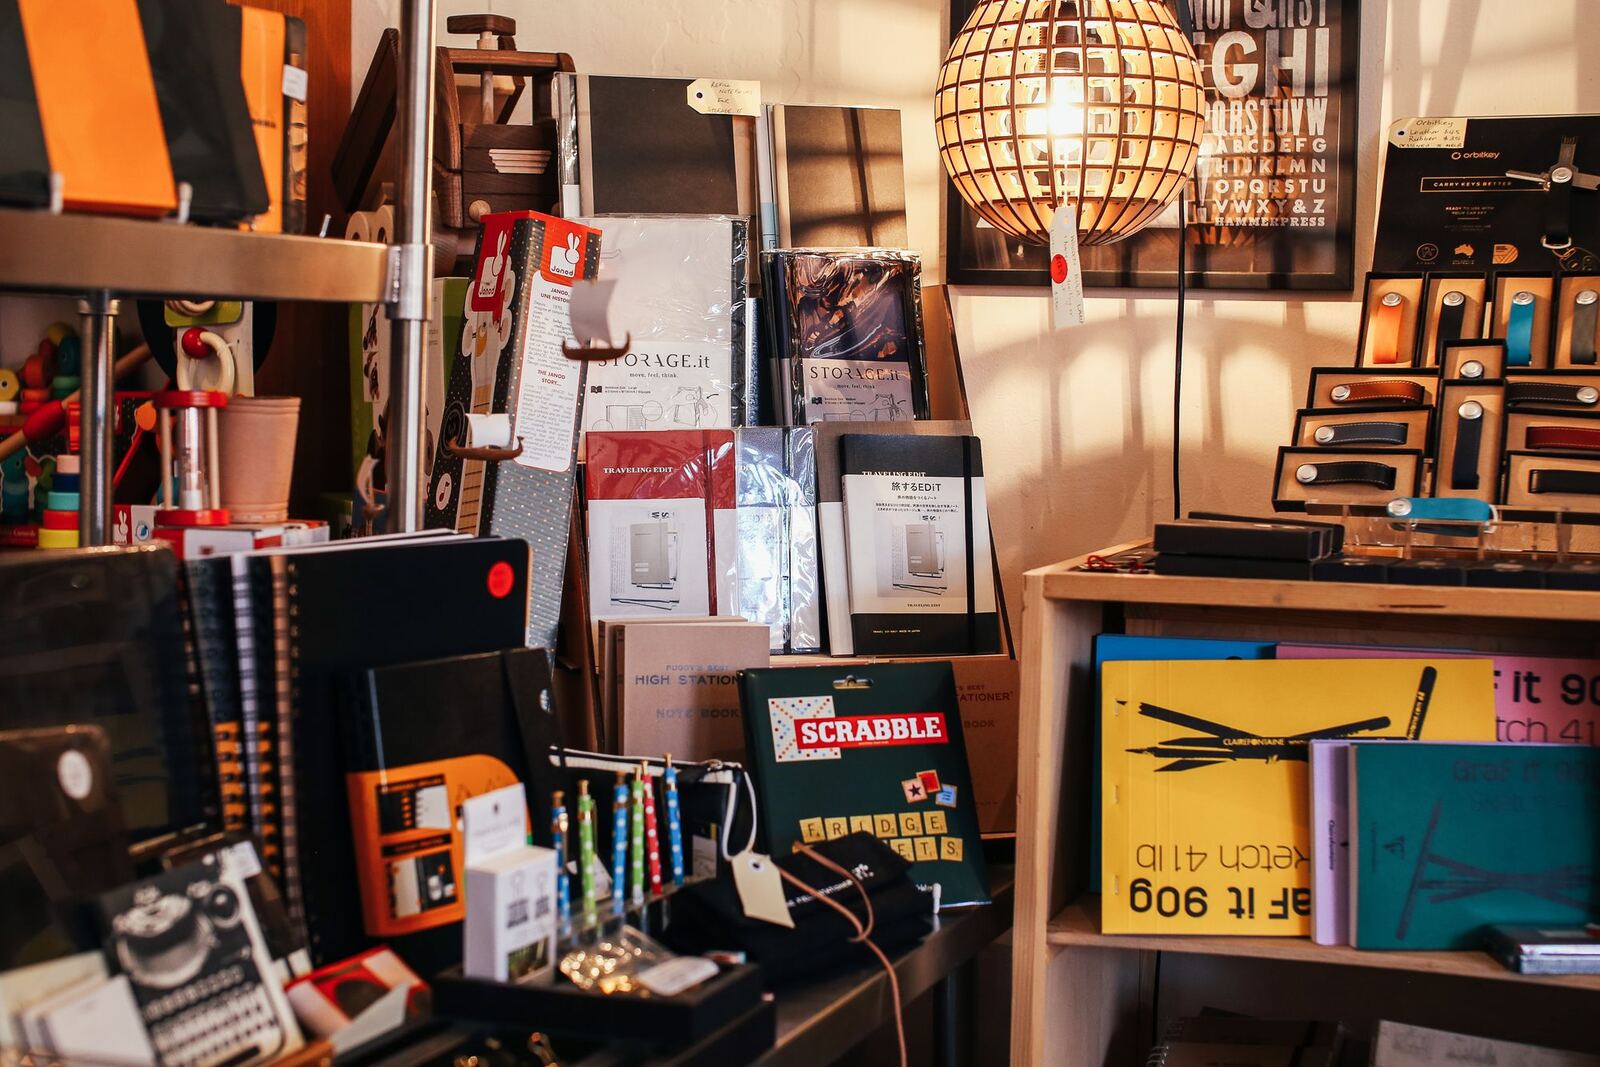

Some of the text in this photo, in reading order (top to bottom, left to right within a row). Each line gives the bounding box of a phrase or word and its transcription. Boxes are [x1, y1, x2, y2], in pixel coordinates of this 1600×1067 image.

[1463, 151, 1500, 160] orbitkey
[1215, 217, 1326, 227] HAMMERPRESS
[551, 265, 574, 277] Janod
[540, 292, 551, 300] UNE
[547, 371, 566, 380] JANOD
[810, 366, 900, 381] STORAGE.it
[653, 466, 674, 474] EDIT
[891, 482, 941, 492] 旅するEDiT
[635, 675, 670, 685] HIGH
[1513, 671, 1541, 704] it
[656, 708, 694, 719] NOTE
[801, 716, 942, 745] SCRABBLE
[1222, 738, 1284, 746] CLAIREFONTAINE
[1129, 878, 1208, 918] 90g
[1227, 886, 1255, 919] it
